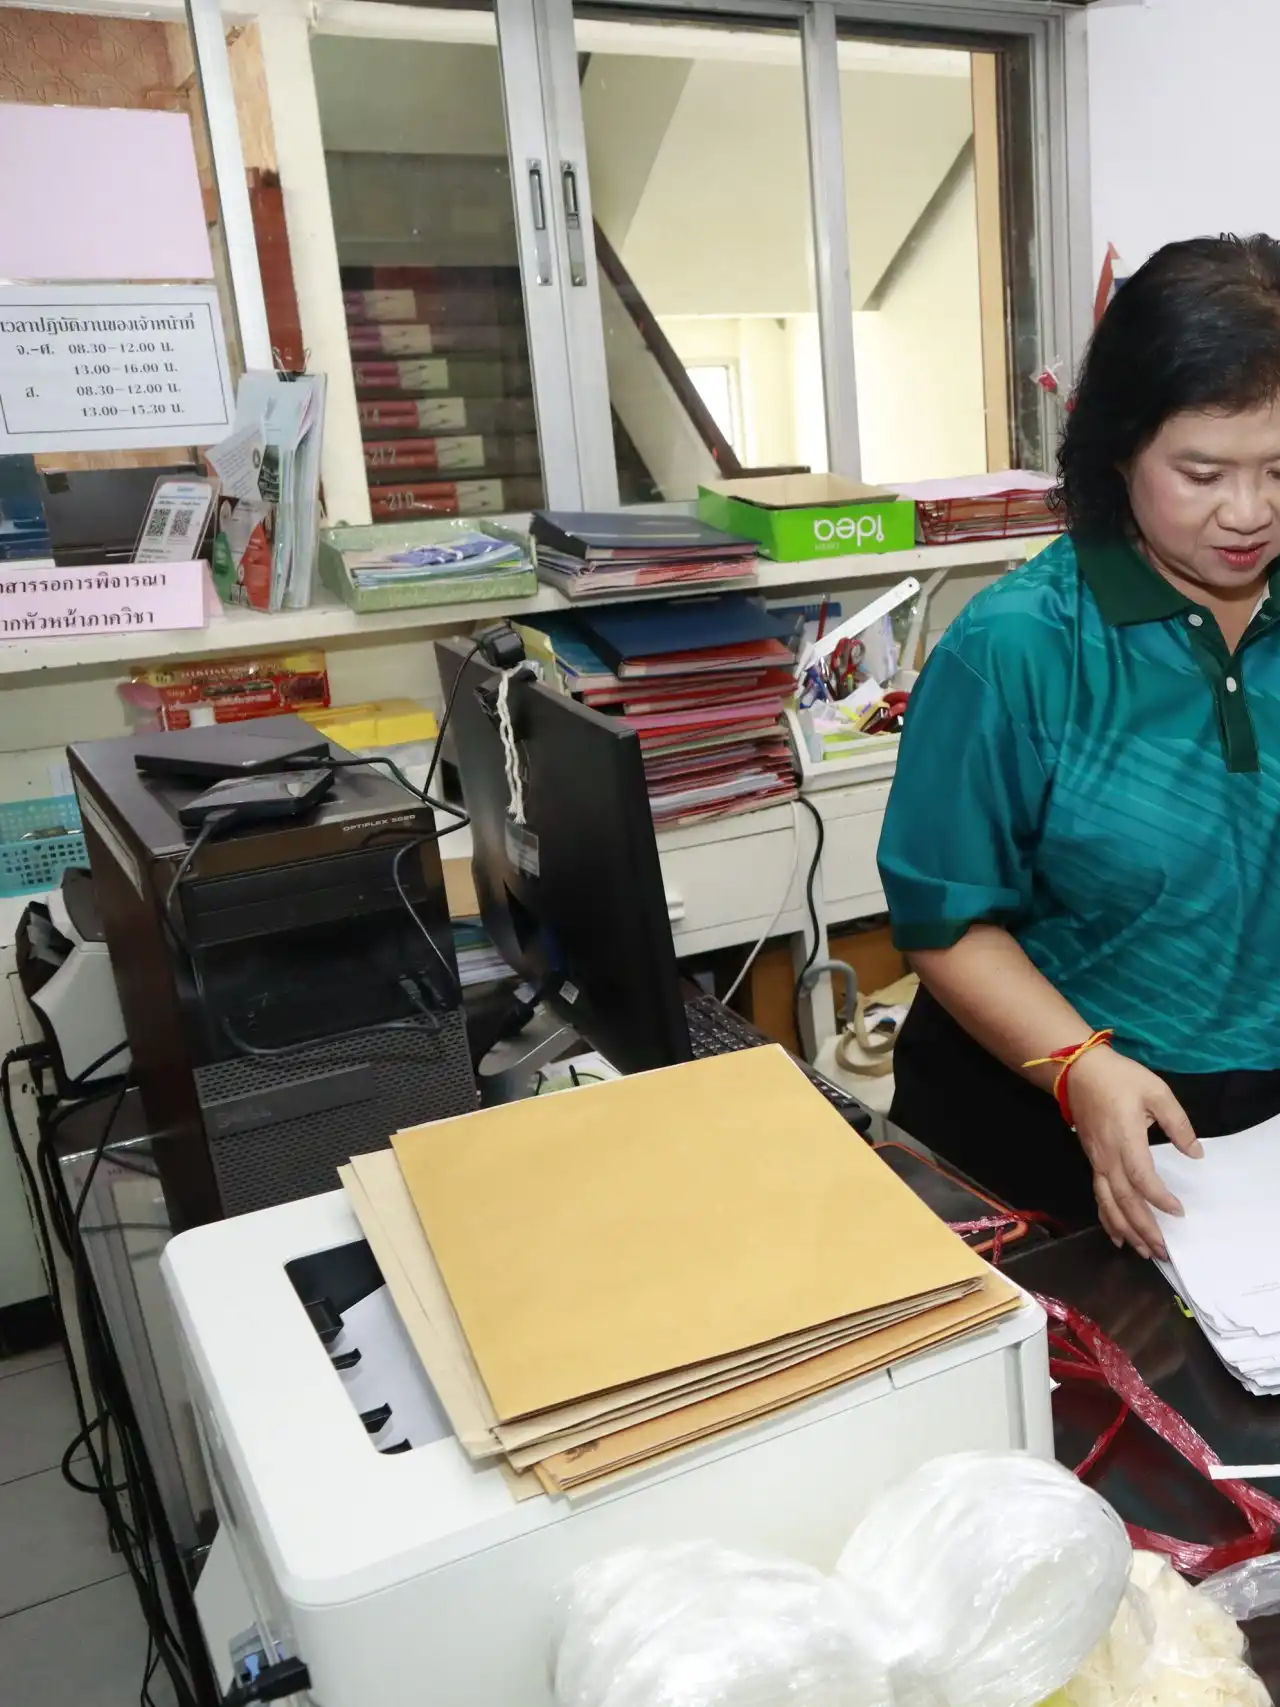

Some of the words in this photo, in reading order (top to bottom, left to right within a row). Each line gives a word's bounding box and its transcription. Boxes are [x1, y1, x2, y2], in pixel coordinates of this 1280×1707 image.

[813, 513, 885, 548] idea
[0, 606, 155, 632] ากหัวหน้าภาควิชา
